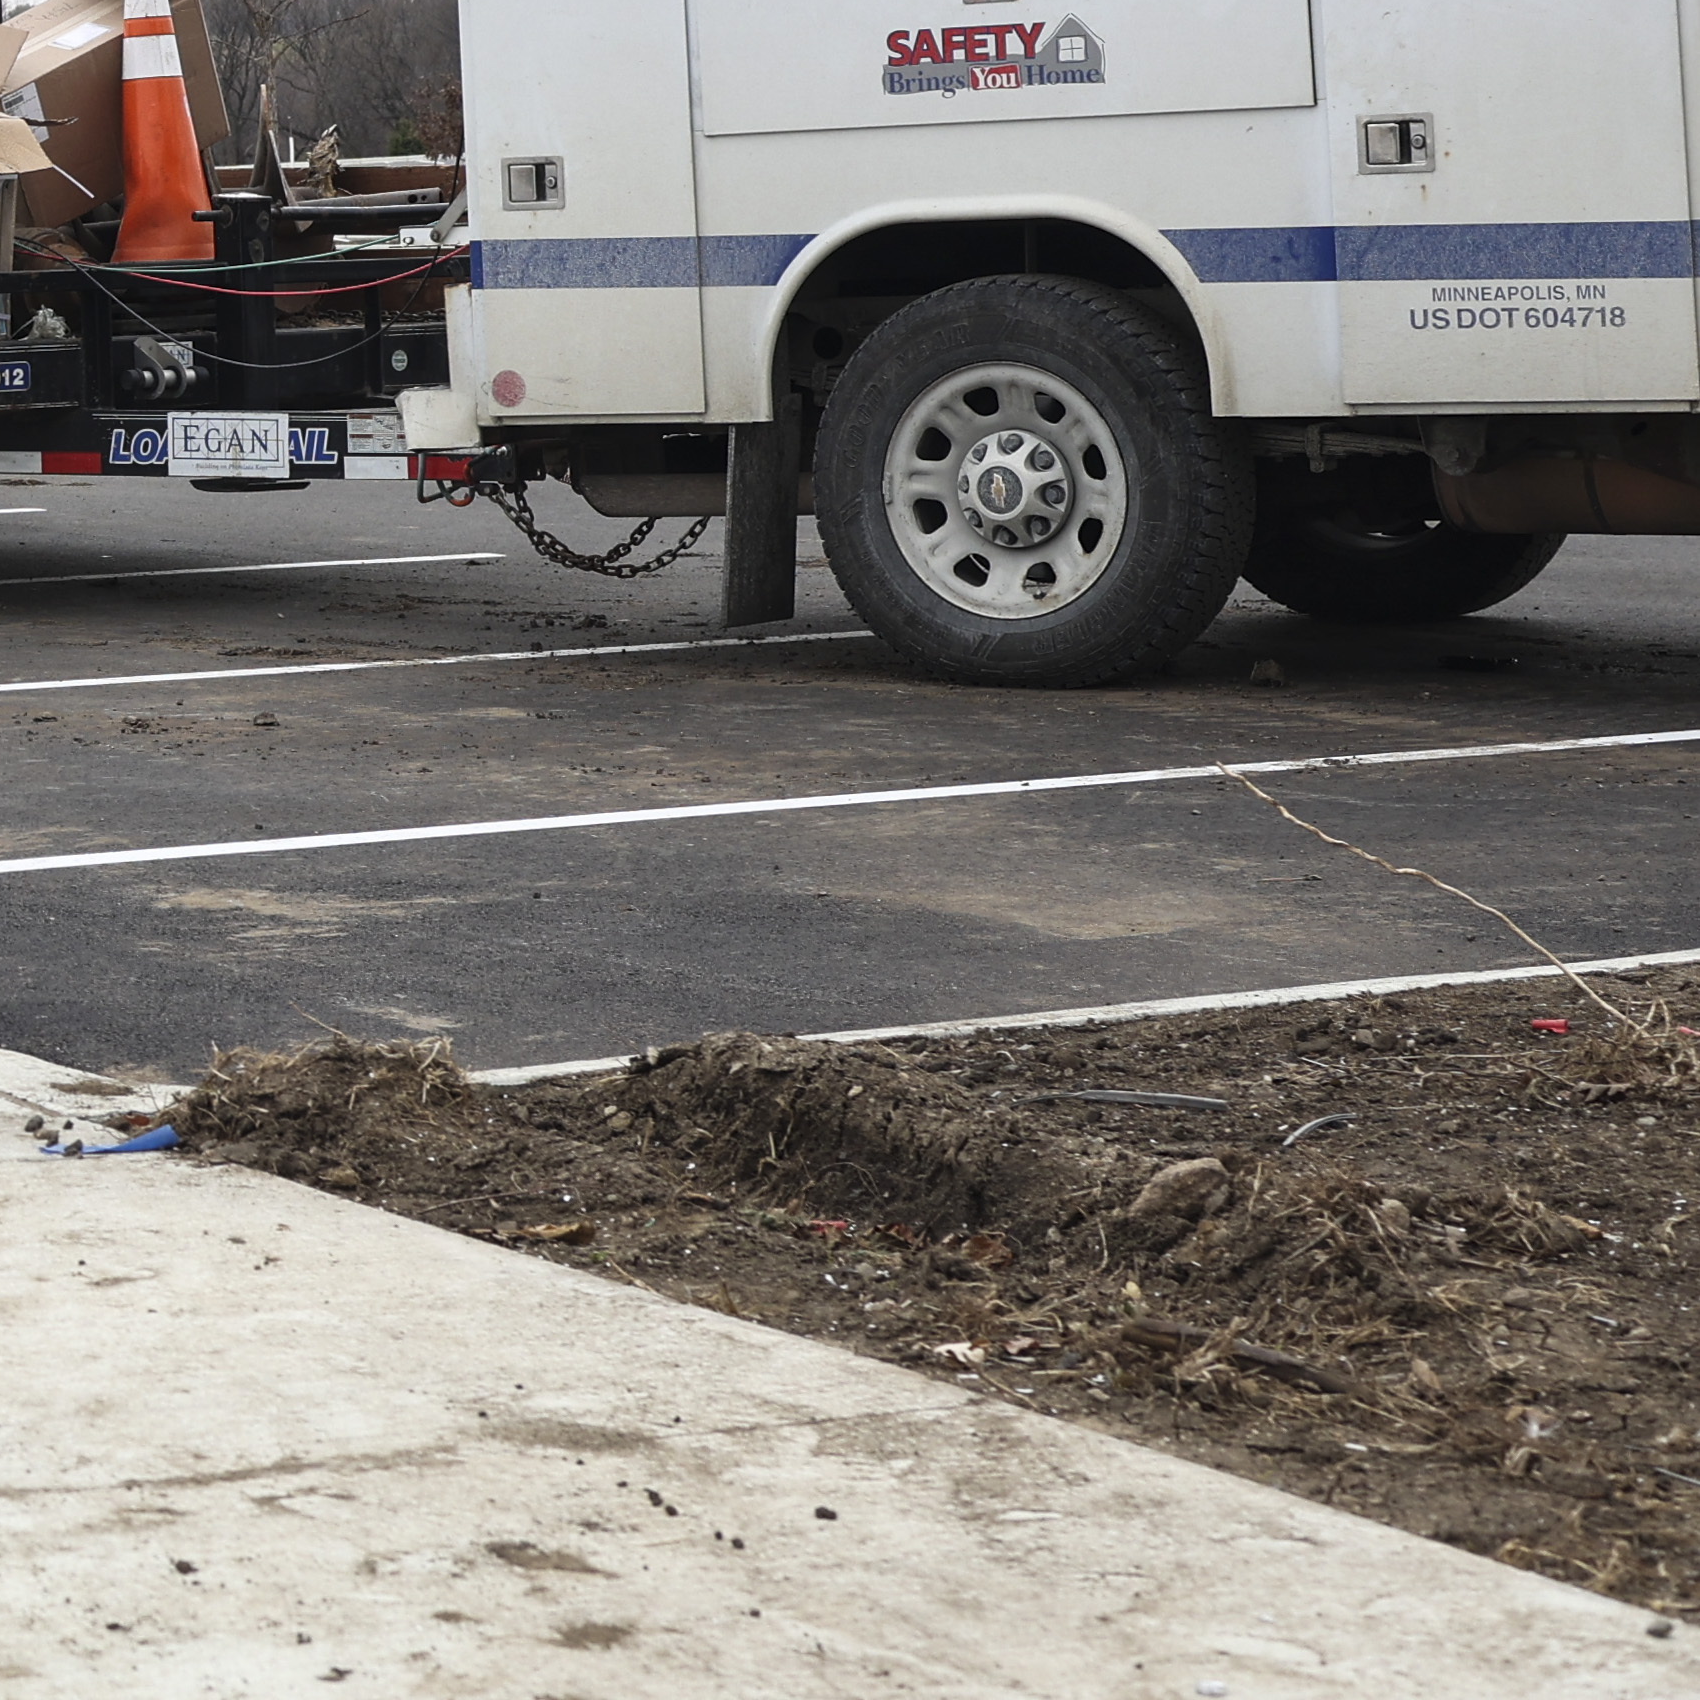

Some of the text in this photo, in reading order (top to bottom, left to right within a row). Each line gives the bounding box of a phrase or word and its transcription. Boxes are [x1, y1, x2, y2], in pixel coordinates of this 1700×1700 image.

[886, 21, 1046, 67] SAFETY
[887, 63, 1101, 99] Brings You Home
[1431, 284, 1606, 302] MINNEAPOLIS, MN
[1409, 306, 1627, 330] US DOT 604718
[180, 423, 270, 455] EGAN
[288, 427, 339, 465] AIL
